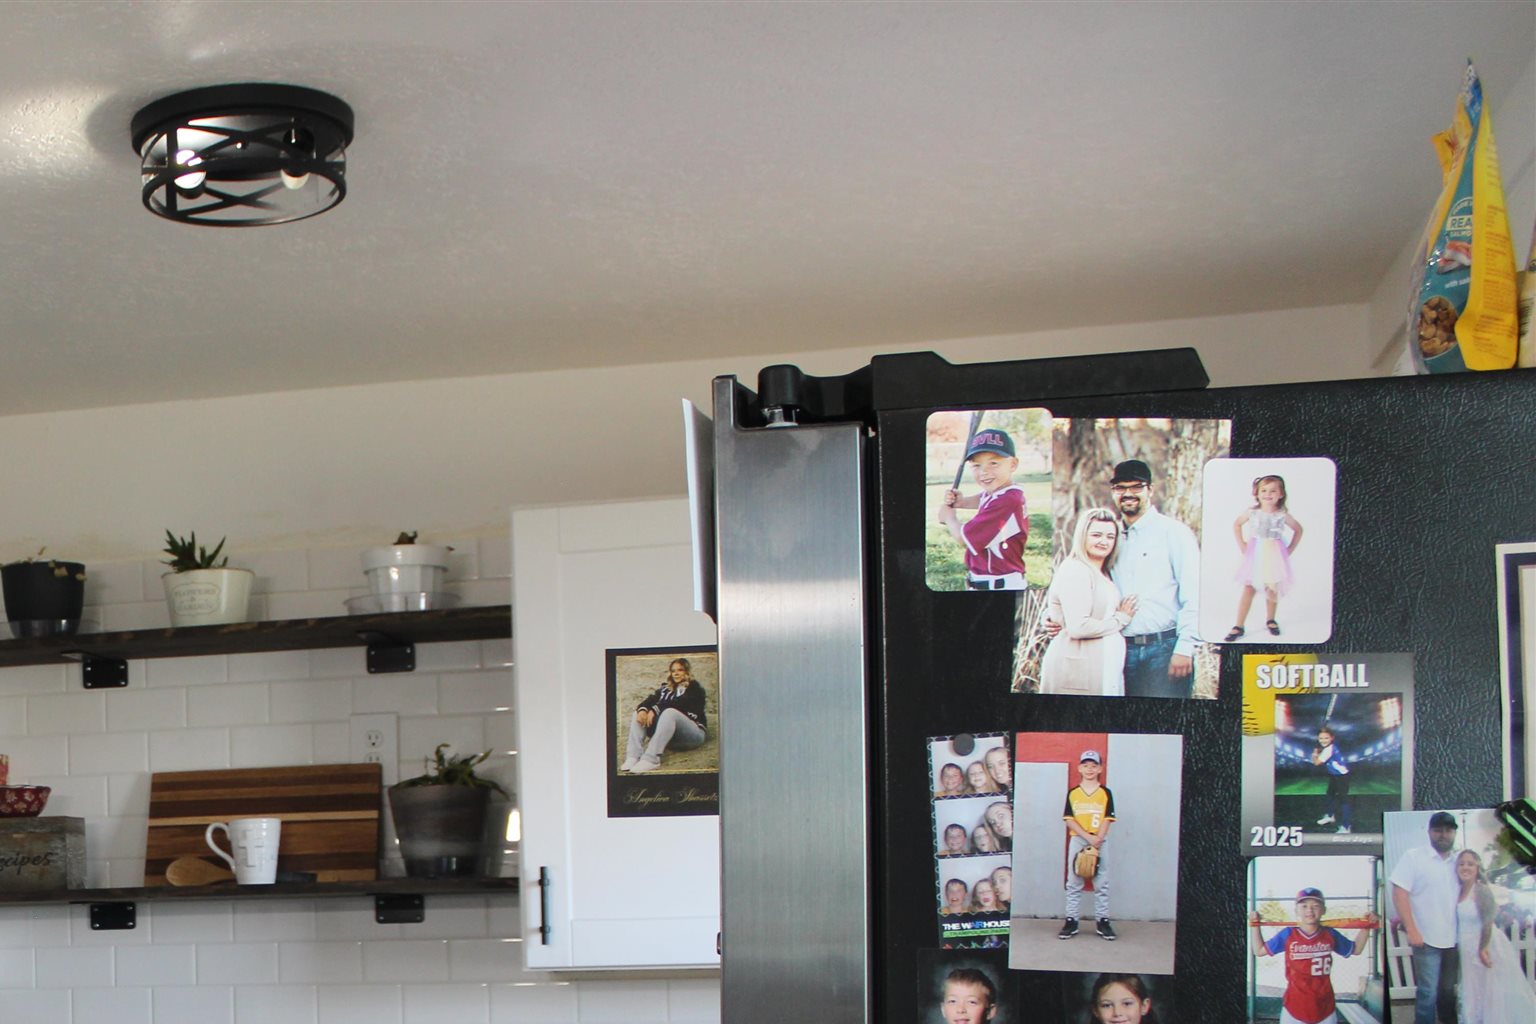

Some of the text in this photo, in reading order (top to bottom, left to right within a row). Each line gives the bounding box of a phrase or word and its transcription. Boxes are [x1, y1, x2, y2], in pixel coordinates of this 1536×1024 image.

[1450, 218, 1473, 228] REA
[1256, 663, 1370, 689] SOFTBALL
[1250, 826, 1303, 847] 2025
[1311, 957, 1331, 976] 26
